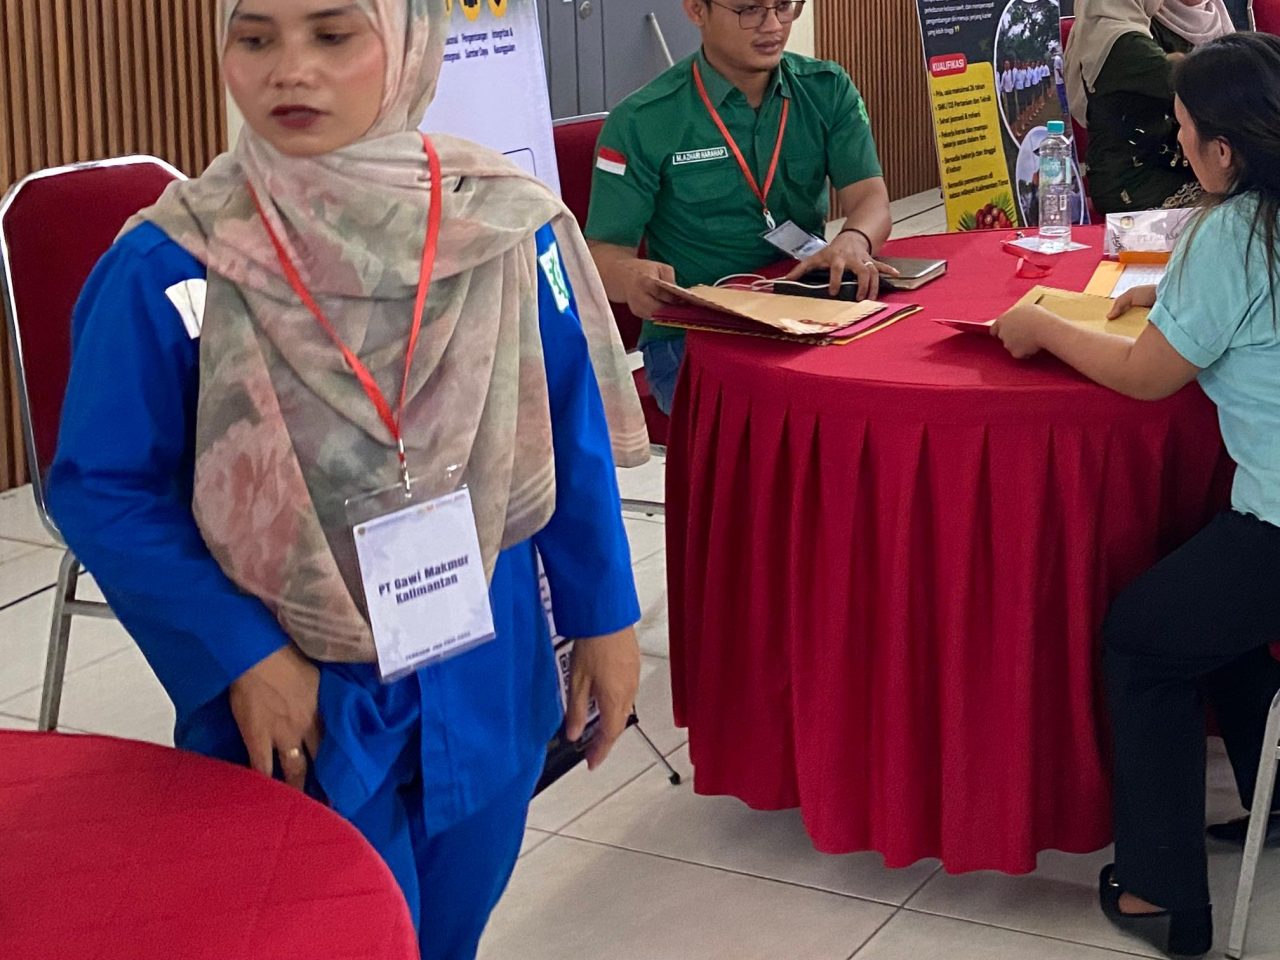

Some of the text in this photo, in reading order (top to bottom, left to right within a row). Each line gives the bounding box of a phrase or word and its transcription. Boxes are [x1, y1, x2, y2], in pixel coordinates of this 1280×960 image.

[932, 59, 964, 72] KUALIFIKASI
[378, 554, 469, 597] PT Gawi Makmur
[396, 574, 458, 605] Kalimantan
